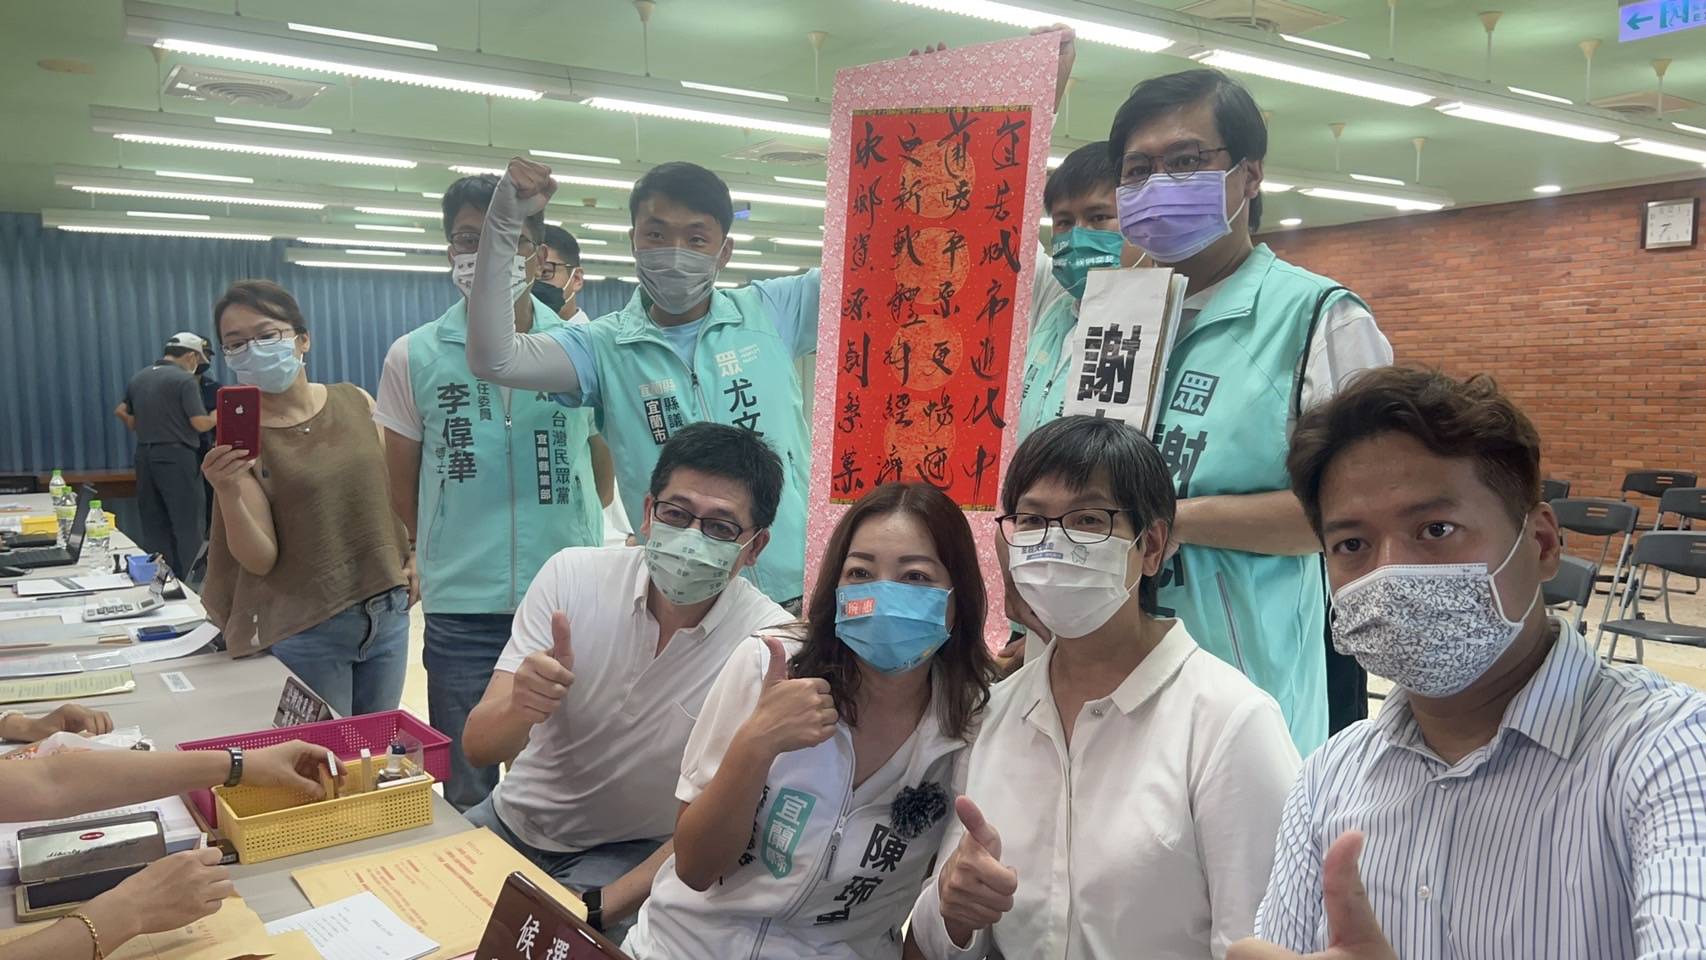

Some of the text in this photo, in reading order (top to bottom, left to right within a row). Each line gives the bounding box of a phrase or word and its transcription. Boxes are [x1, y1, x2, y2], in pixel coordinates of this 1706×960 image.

[437, 382, 477, 483] 李偉華
[476, 379, 492, 421] 任委員
[646, 400, 667, 442] 宜蘭市
[552, 410, 570, 504] 台灣民眾黨
